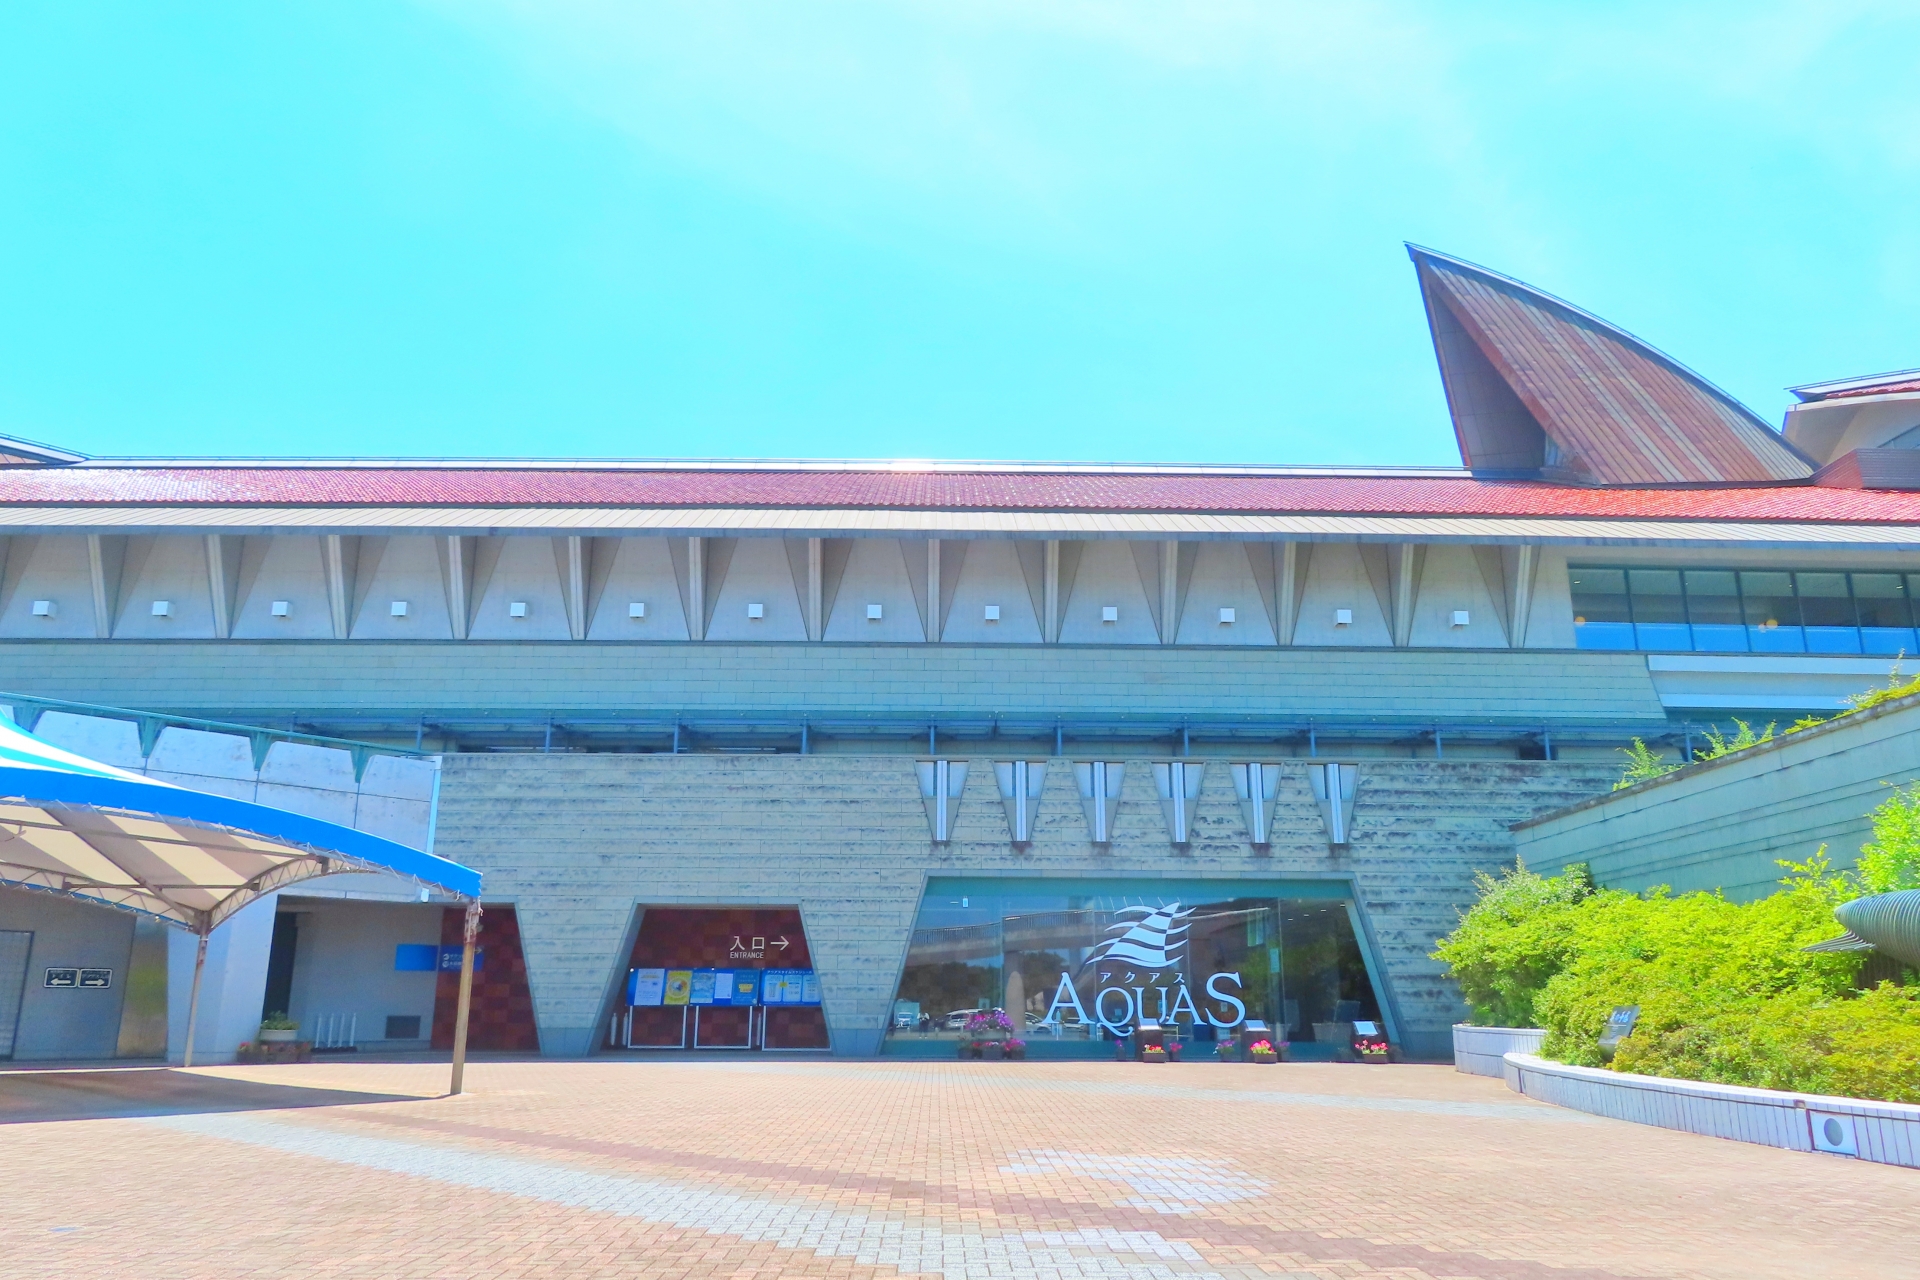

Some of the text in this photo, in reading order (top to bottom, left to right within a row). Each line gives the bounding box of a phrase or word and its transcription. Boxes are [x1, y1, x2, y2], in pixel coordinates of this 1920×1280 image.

[730, 936, 764, 951] 入口
[1100, 971, 1185, 983] アクアス
[1042, 971, 1246, 1037] AQUAS
